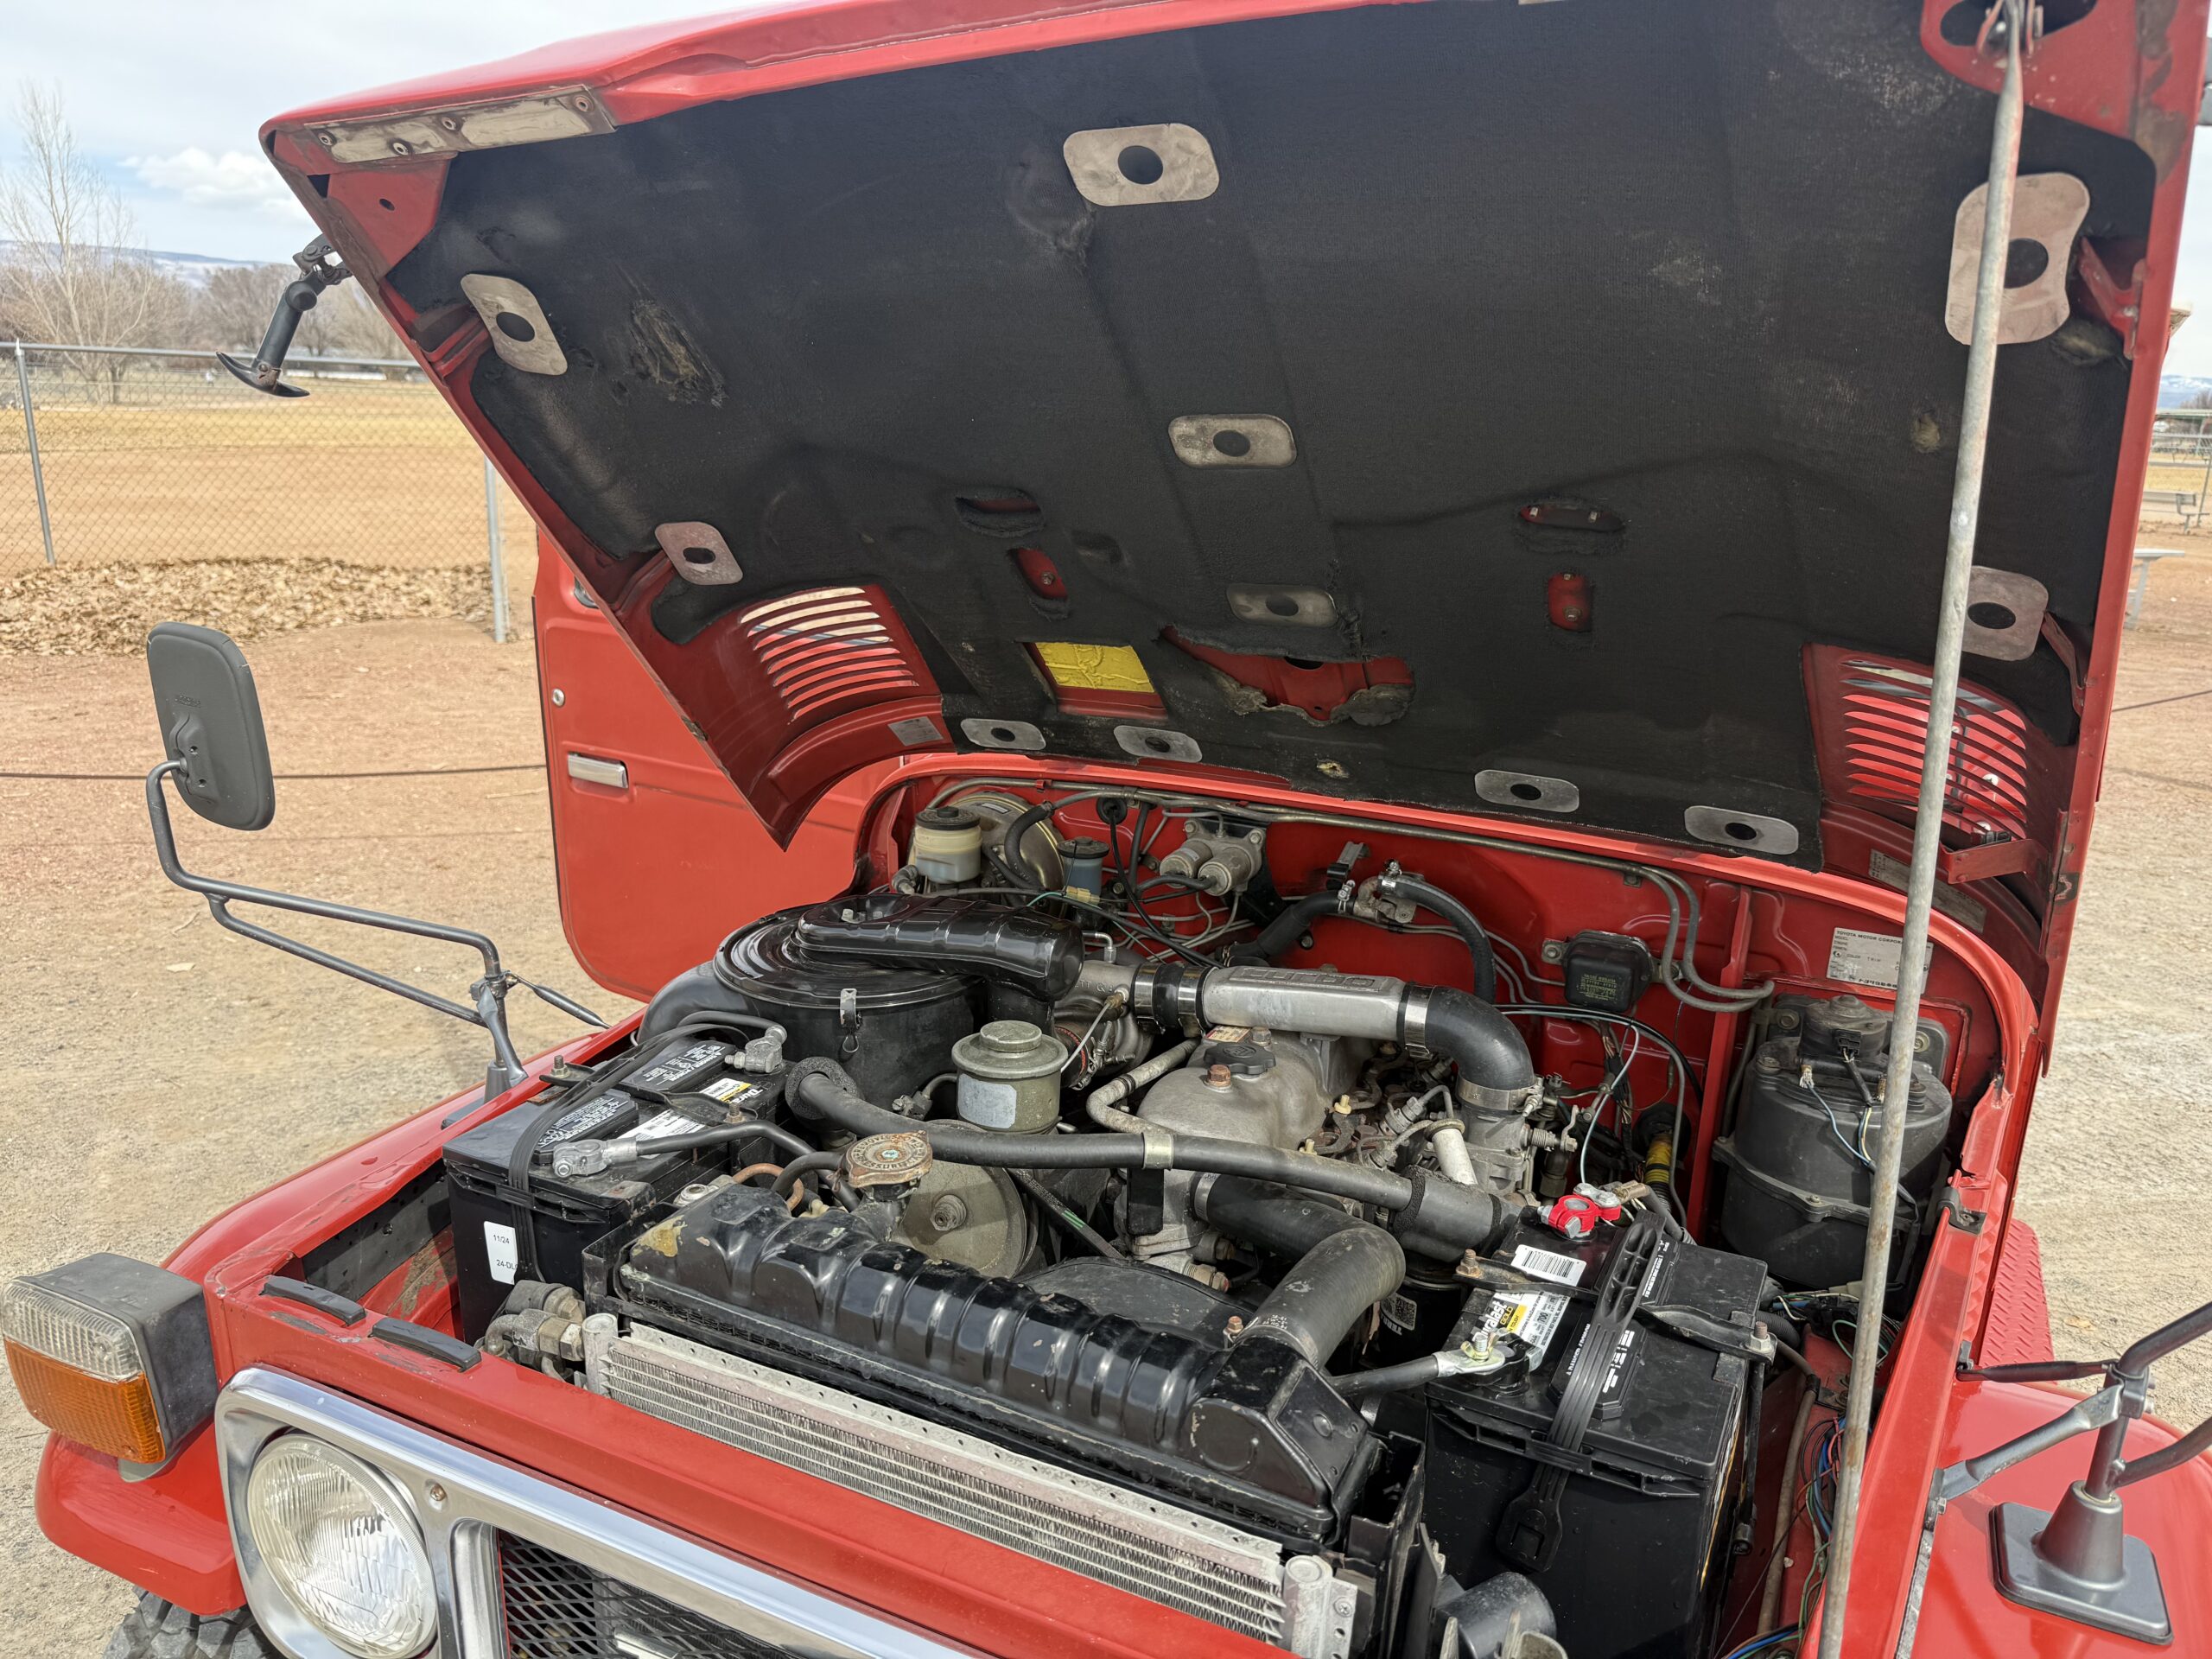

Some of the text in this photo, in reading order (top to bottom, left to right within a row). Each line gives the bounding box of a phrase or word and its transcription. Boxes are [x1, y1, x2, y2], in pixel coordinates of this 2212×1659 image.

[729, 1088, 764, 1103] Dura
[493, 1234, 510, 1244] 11/24
[1499, 1306, 1514, 1325] GOLD
[1537, 1312, 1548, 1323] 700
